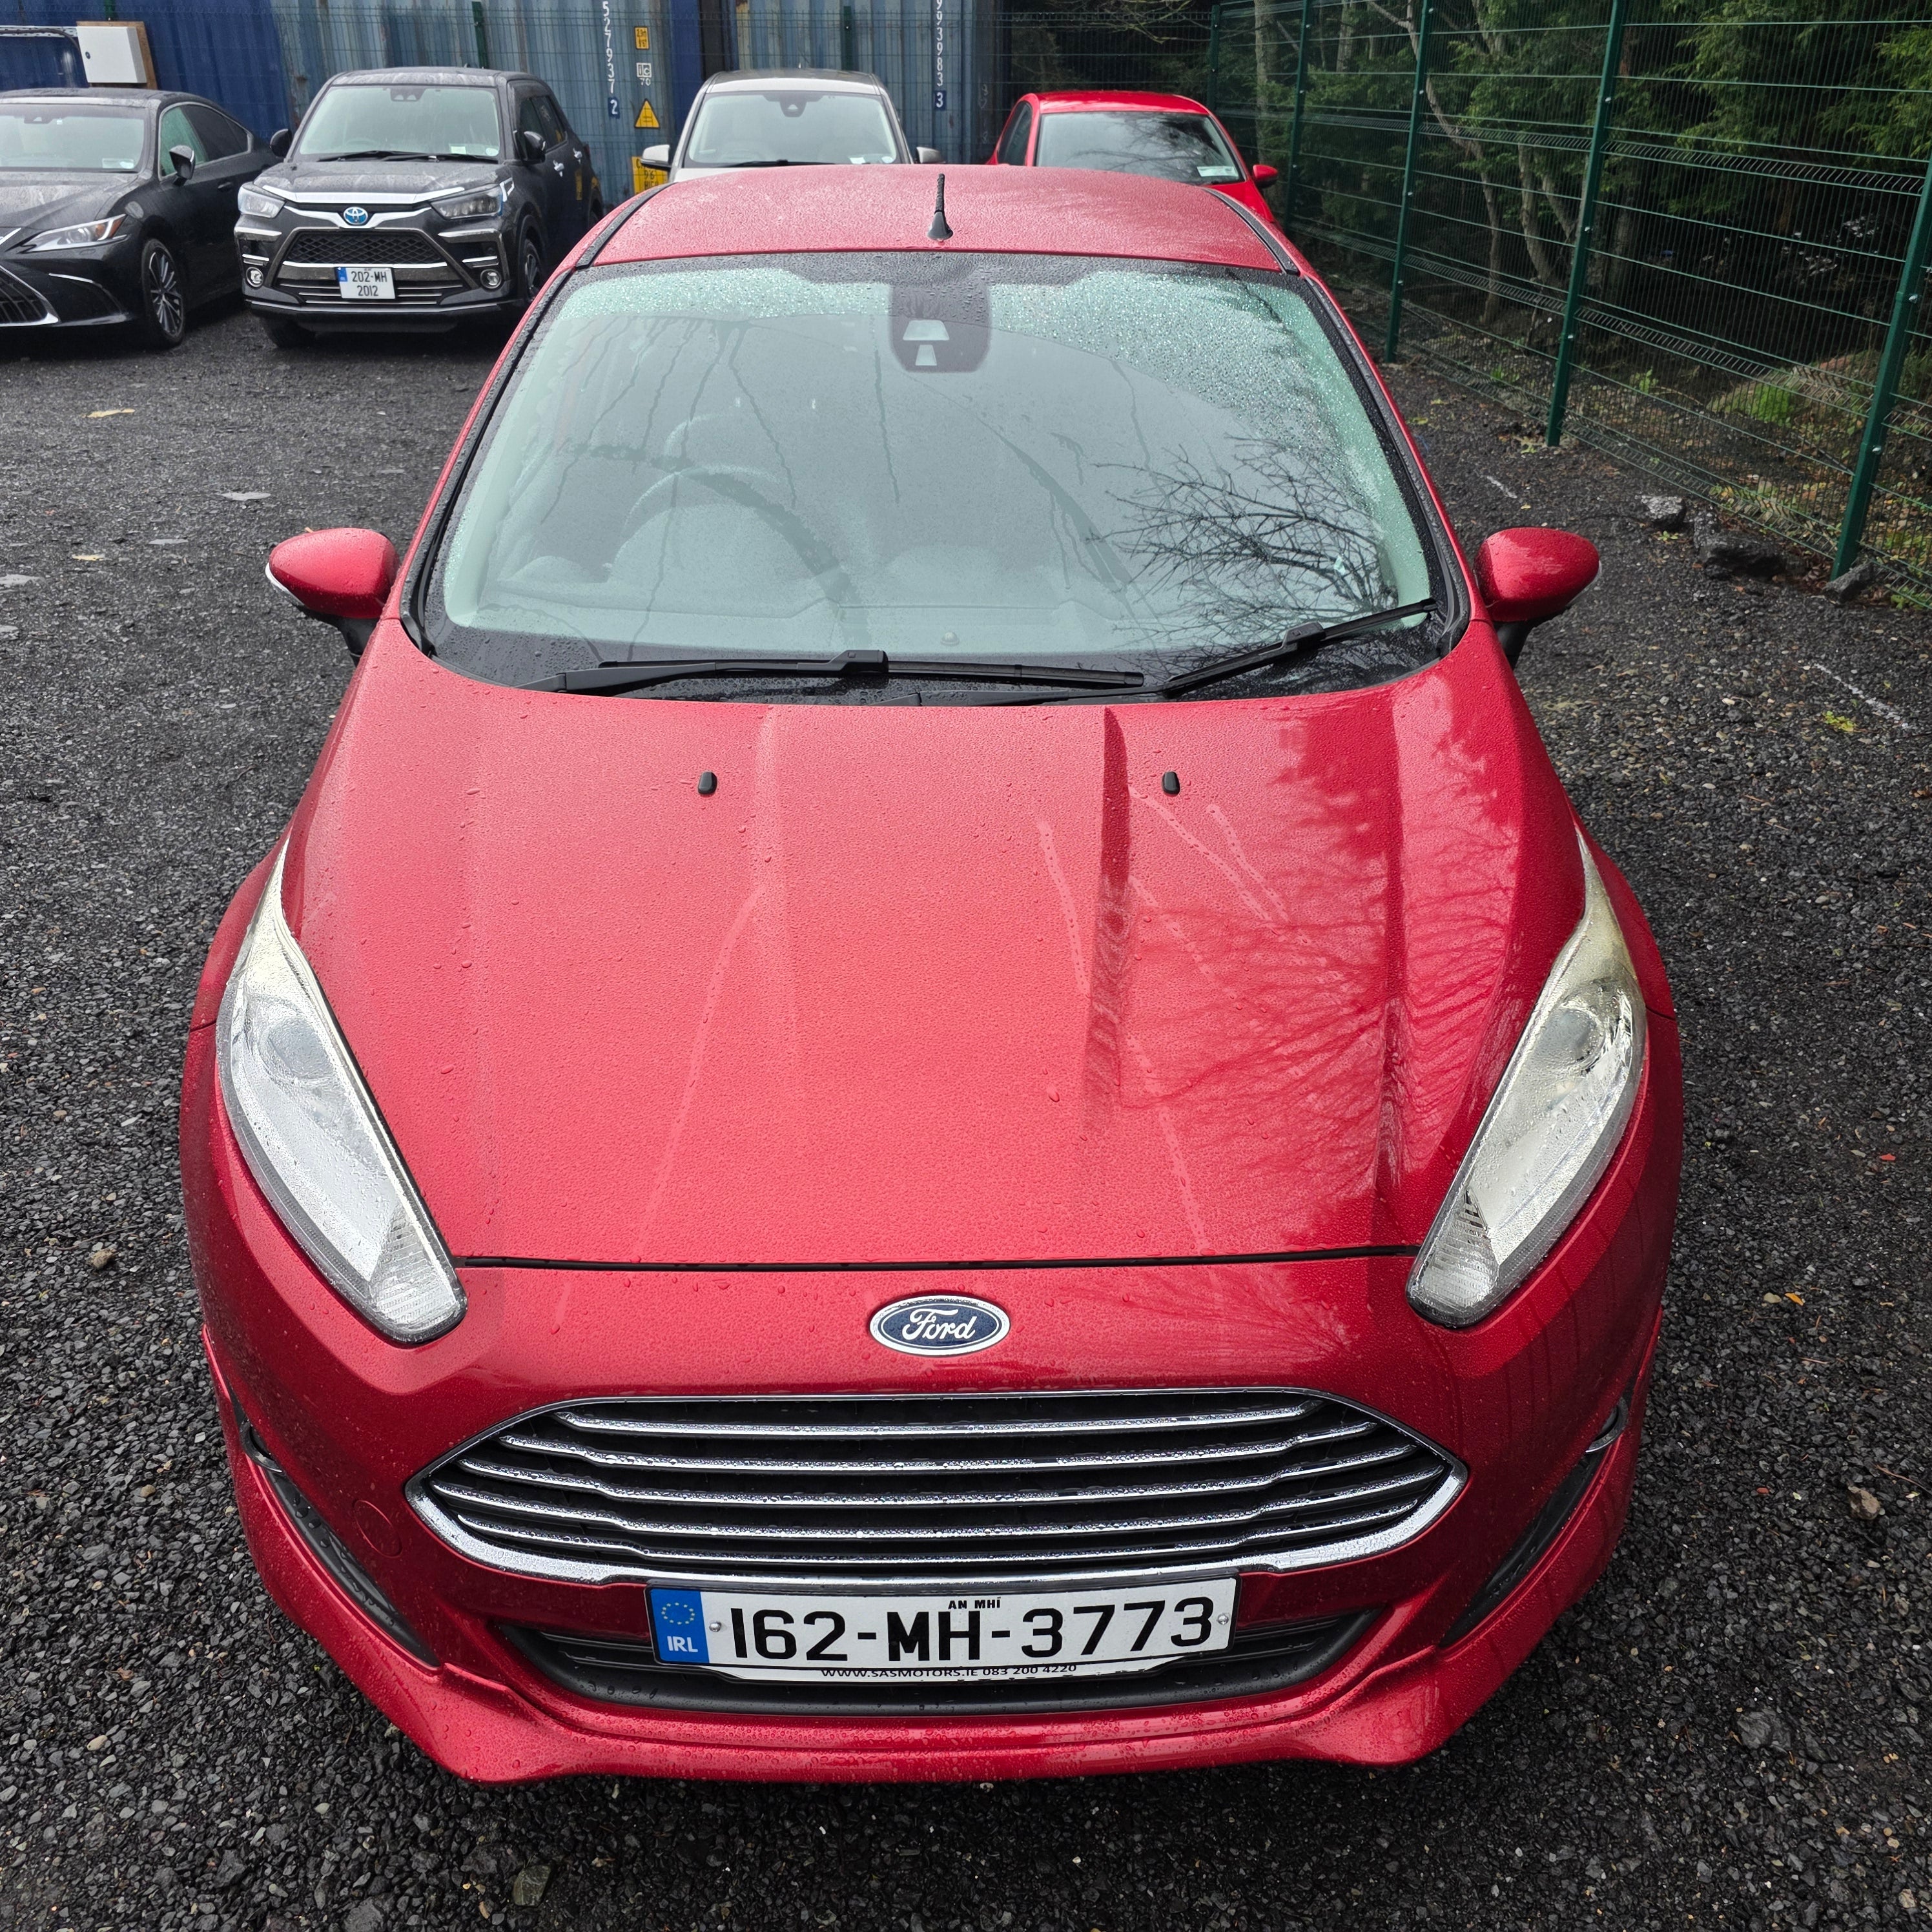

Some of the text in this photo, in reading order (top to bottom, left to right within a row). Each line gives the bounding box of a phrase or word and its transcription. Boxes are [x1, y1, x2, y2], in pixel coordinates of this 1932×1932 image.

[351, 271, 387, 282] 202-MH
[356, 285, 379, 296] 2012
[901, 1308, 978, 1341] Ford
[947, 1599, 967, 1610] AN
[730, 1596, 1215, 1662] 162-MH-3773
[666, 1636, 699, 1652] IRL
[821, 1669, 978, 1678] WWW.SASMOTORS.IE
[1042, 1665, 1077, 1673] 4220
